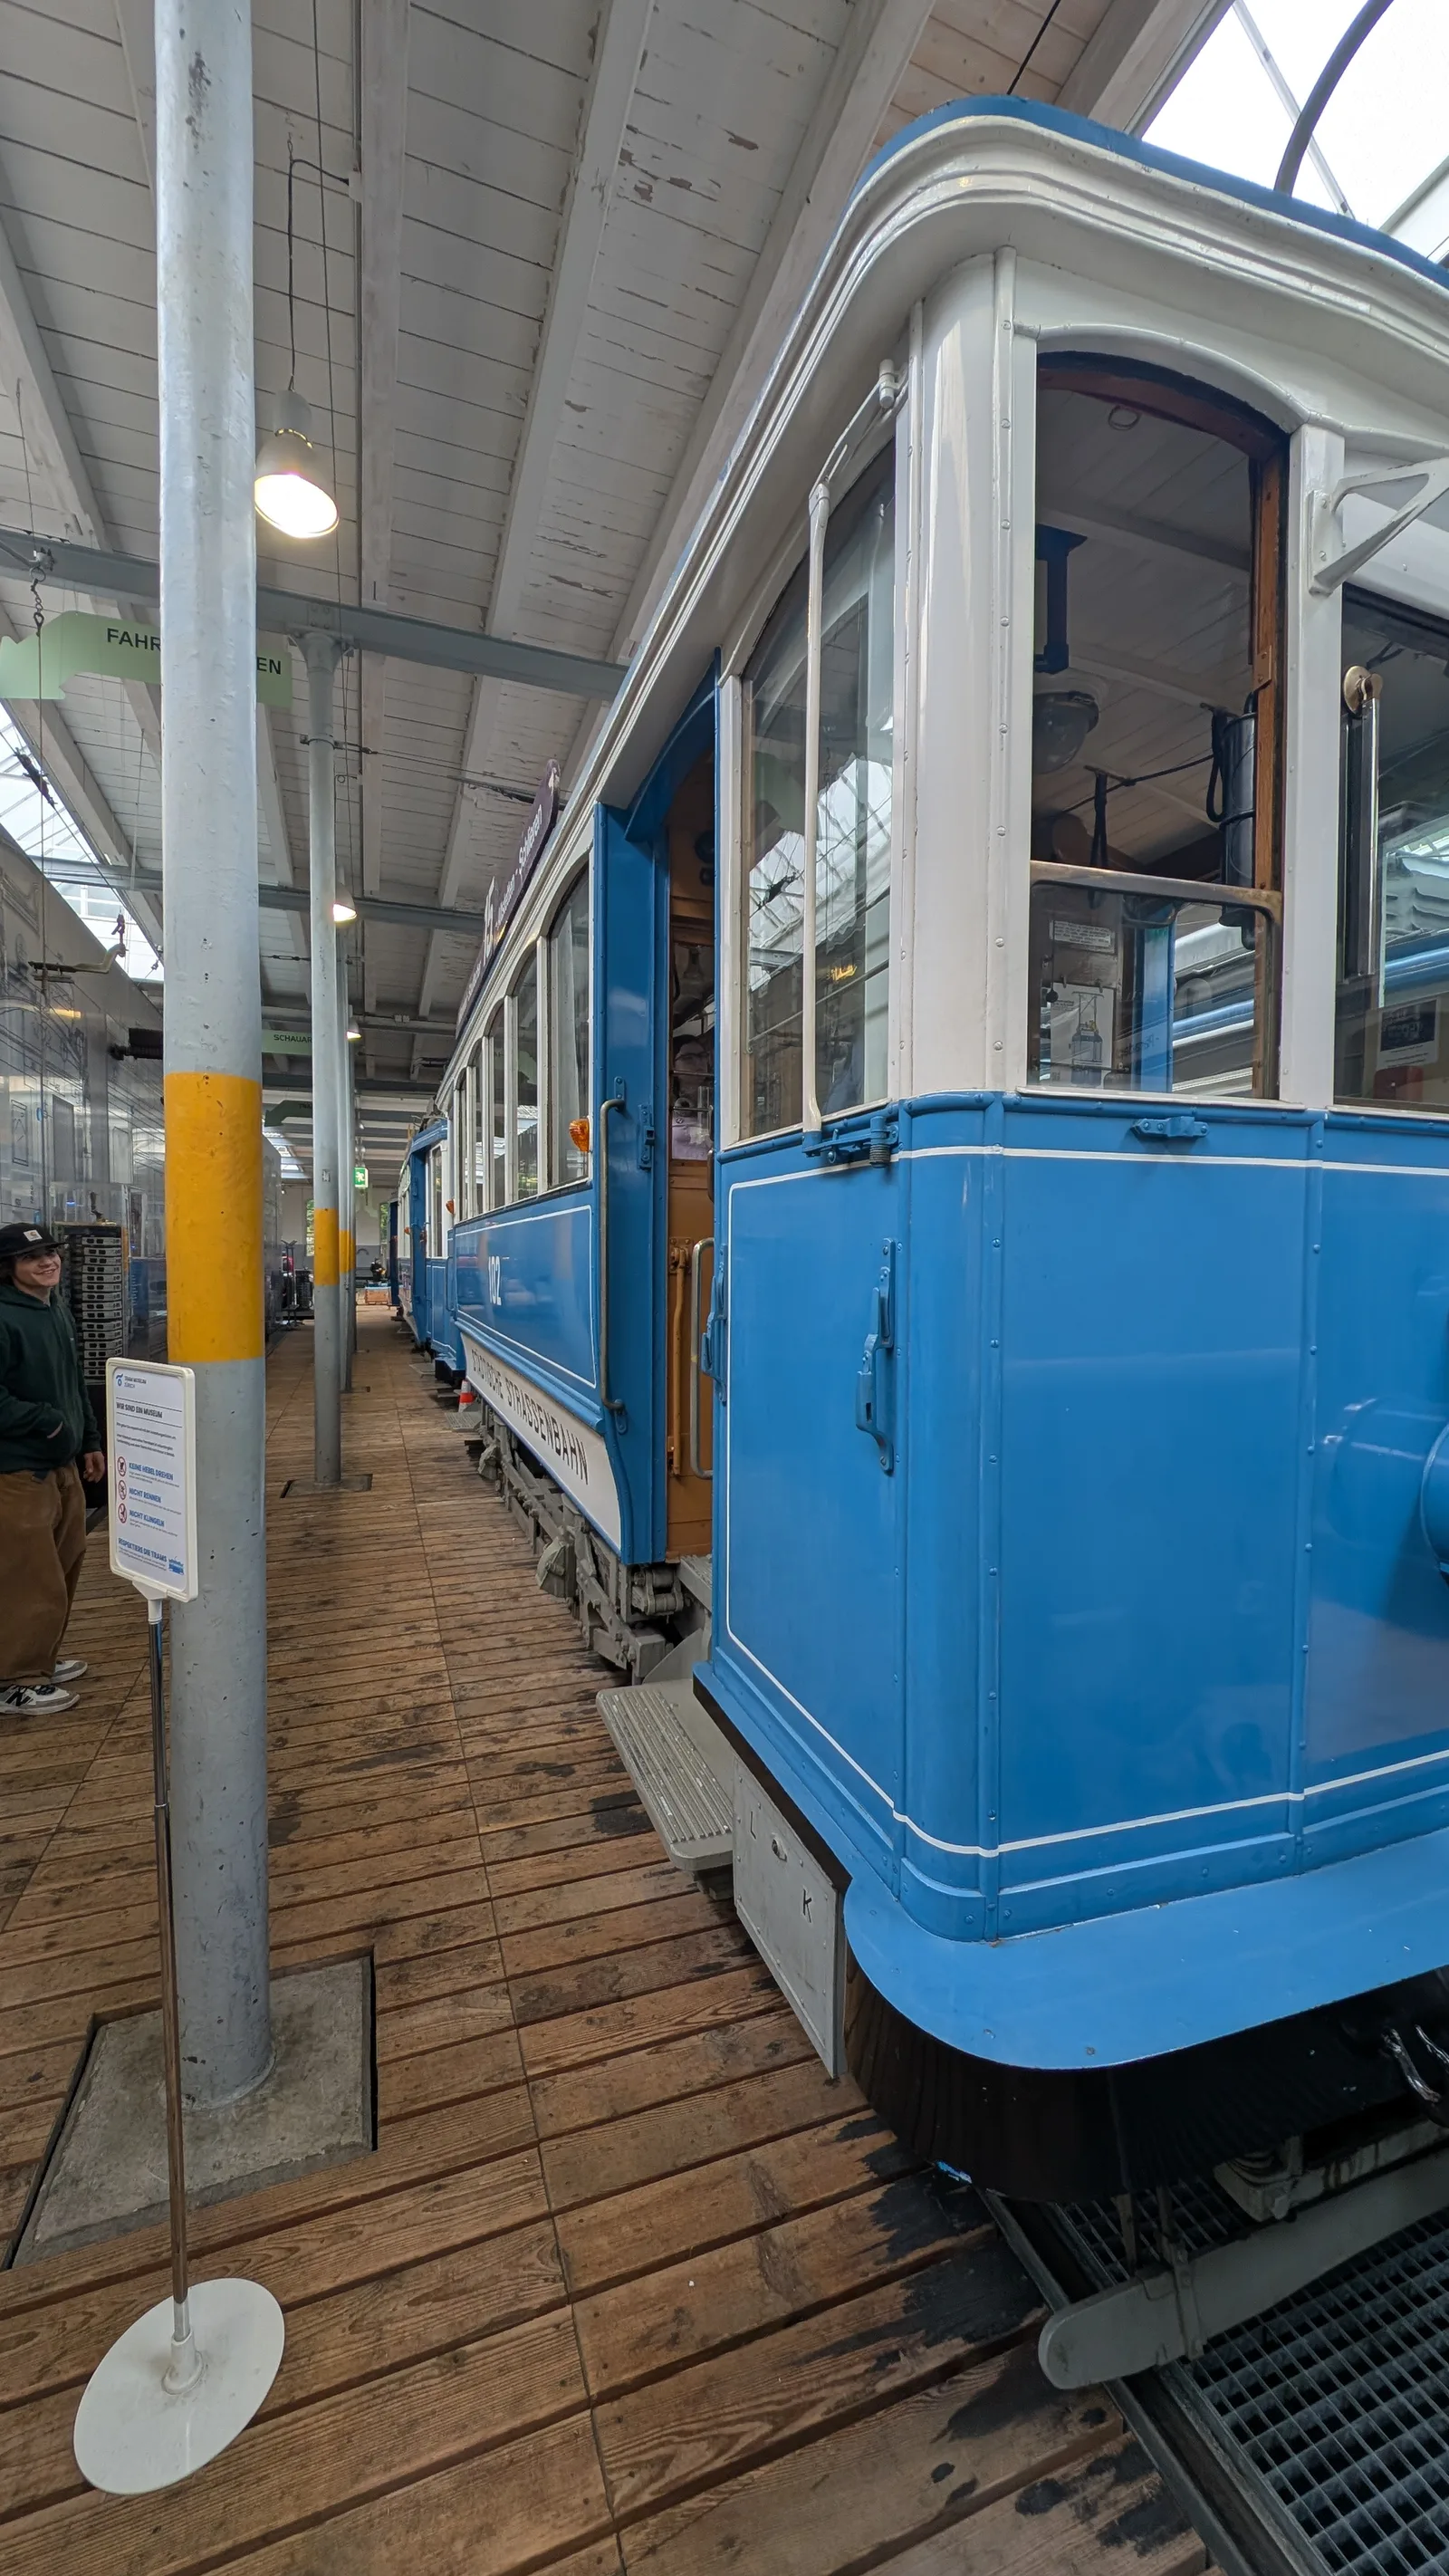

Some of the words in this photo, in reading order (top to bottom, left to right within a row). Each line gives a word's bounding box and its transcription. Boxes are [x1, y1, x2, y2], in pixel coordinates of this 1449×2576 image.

[107, 627, 161, 651] FAHR
[257, 657, 282, 675] EN
[273, 1033, 312, 1043] SCHAUAR
[488, 1256, 502, 1306] 102
[125, 1404, 135, 1412] SIND
[143, 1408, 163, 1418] MUSEUM
[504, 1377, 589, 1485] STRASSENBAHN
[129, 1462, 142, 1472] KEINE
[142, 1465, 155, 1475] HEBEL
[155, 1468, 174, 1481] DREHEN
[129, 1487, 143, 1497] NICHT
[143, 1490, 162, 1504] RENNEN
[129, 1509, 143, 1521] NICHT
[143, 1513, 165, 1527] KLINGELN
[150, 1549, 168, 1562] TRAMS
[802, 1889, 812, 1923] K
